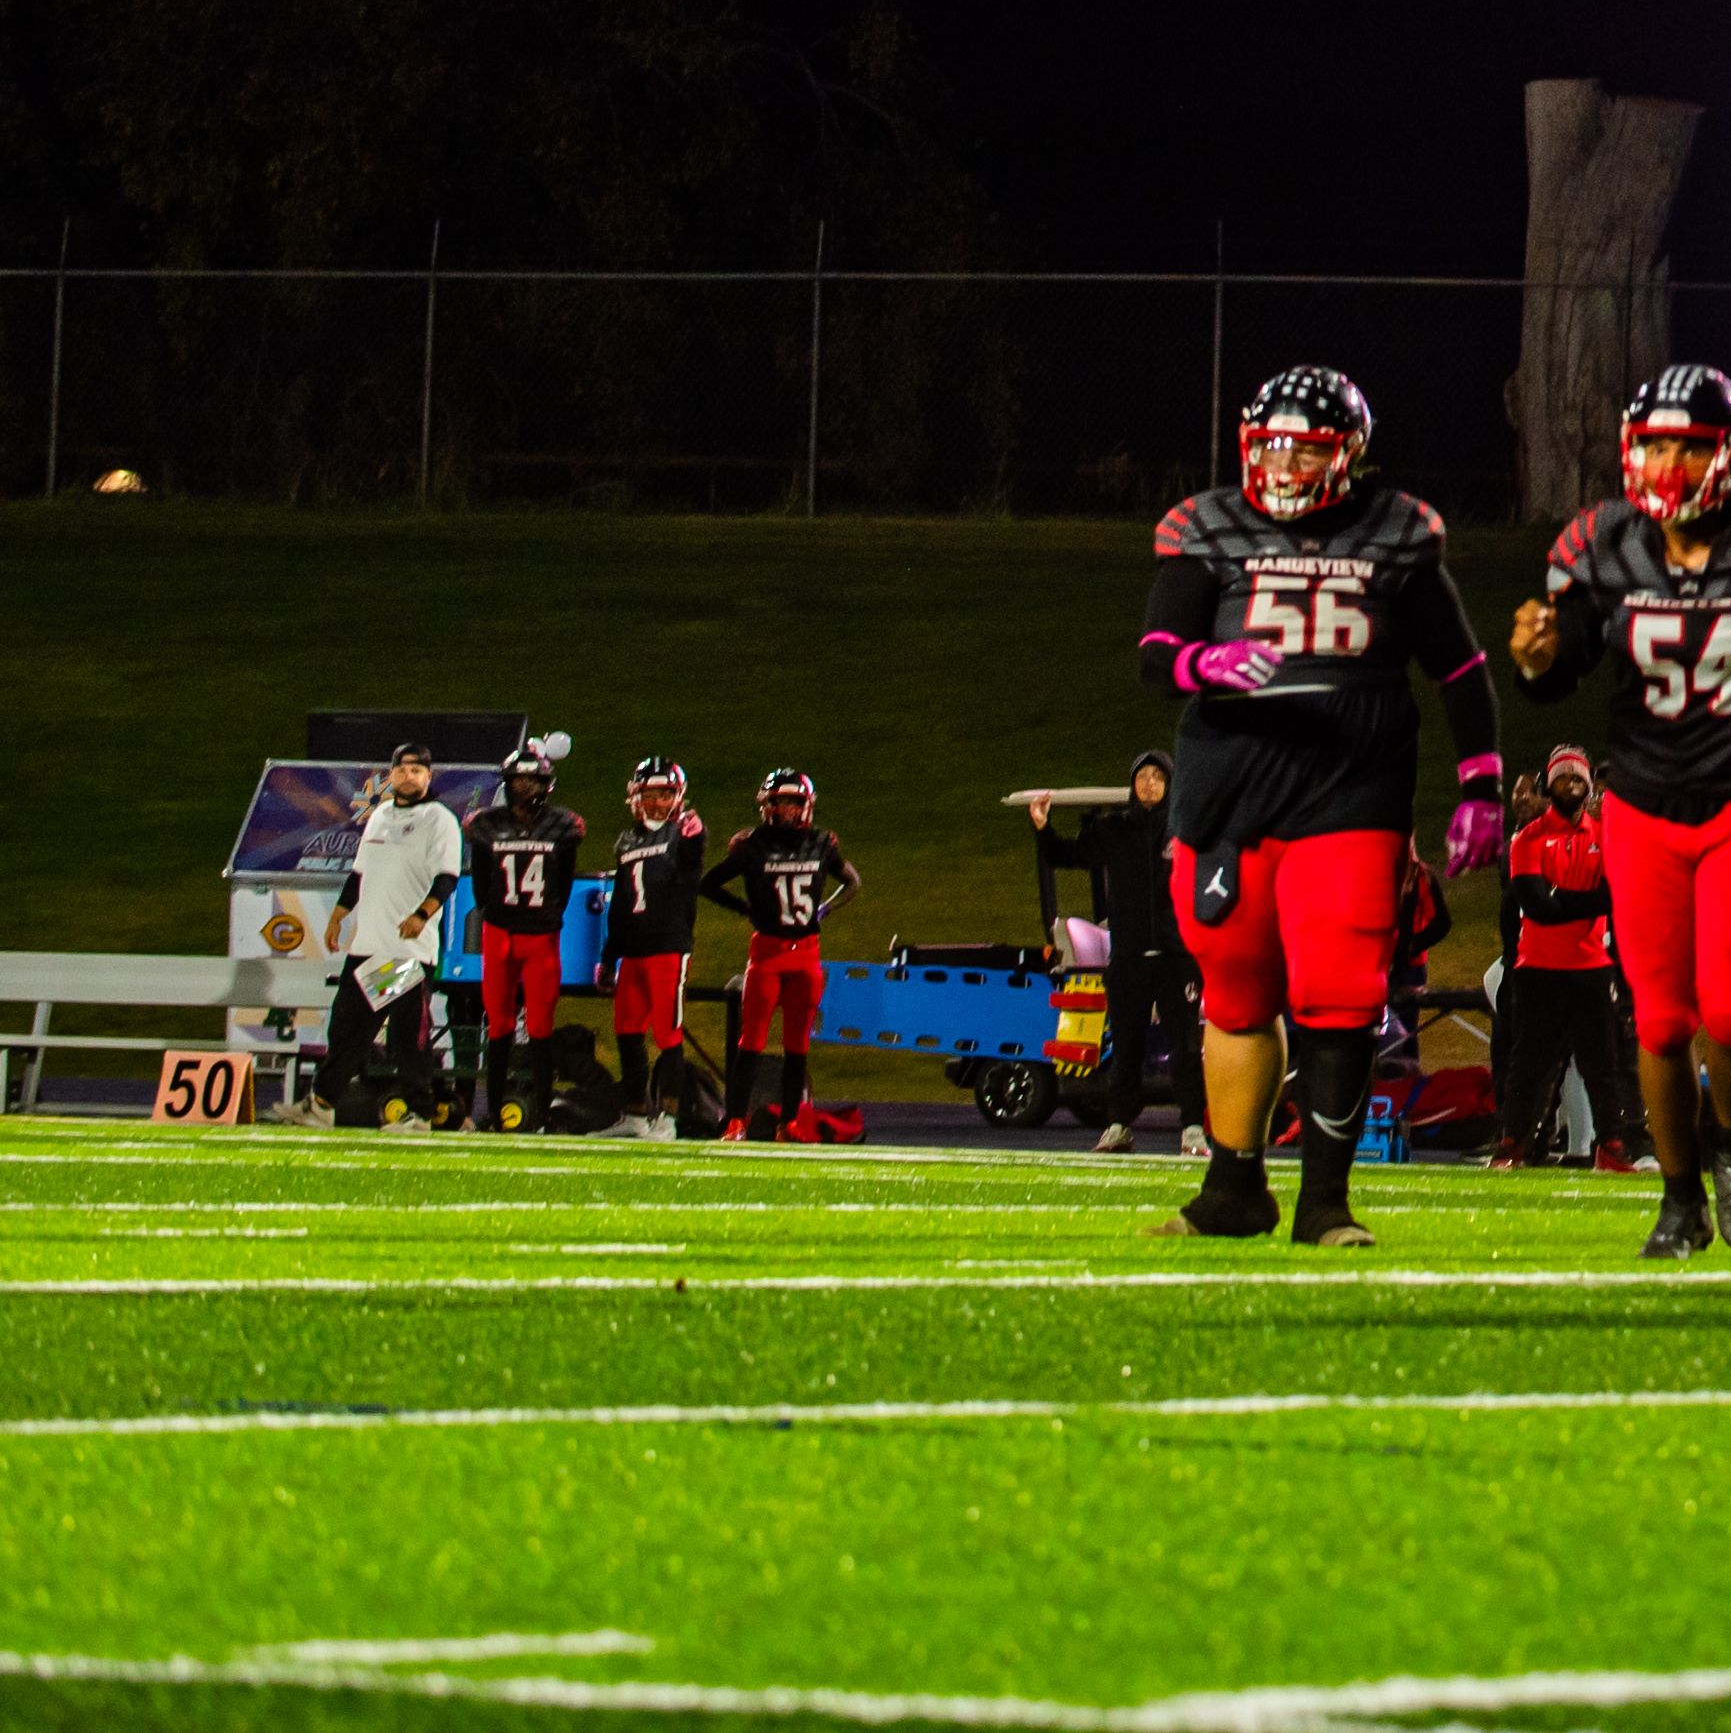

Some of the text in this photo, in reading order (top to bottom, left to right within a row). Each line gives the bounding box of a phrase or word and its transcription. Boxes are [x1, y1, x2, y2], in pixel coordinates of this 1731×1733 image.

[1243, 573, 1373, 657] 56
[501, 853, 546, 908] 14
[631, 860, 647, 915] 1
[774, 873, 815, 927] 15
[163, 1059, 235, 1120] 50
